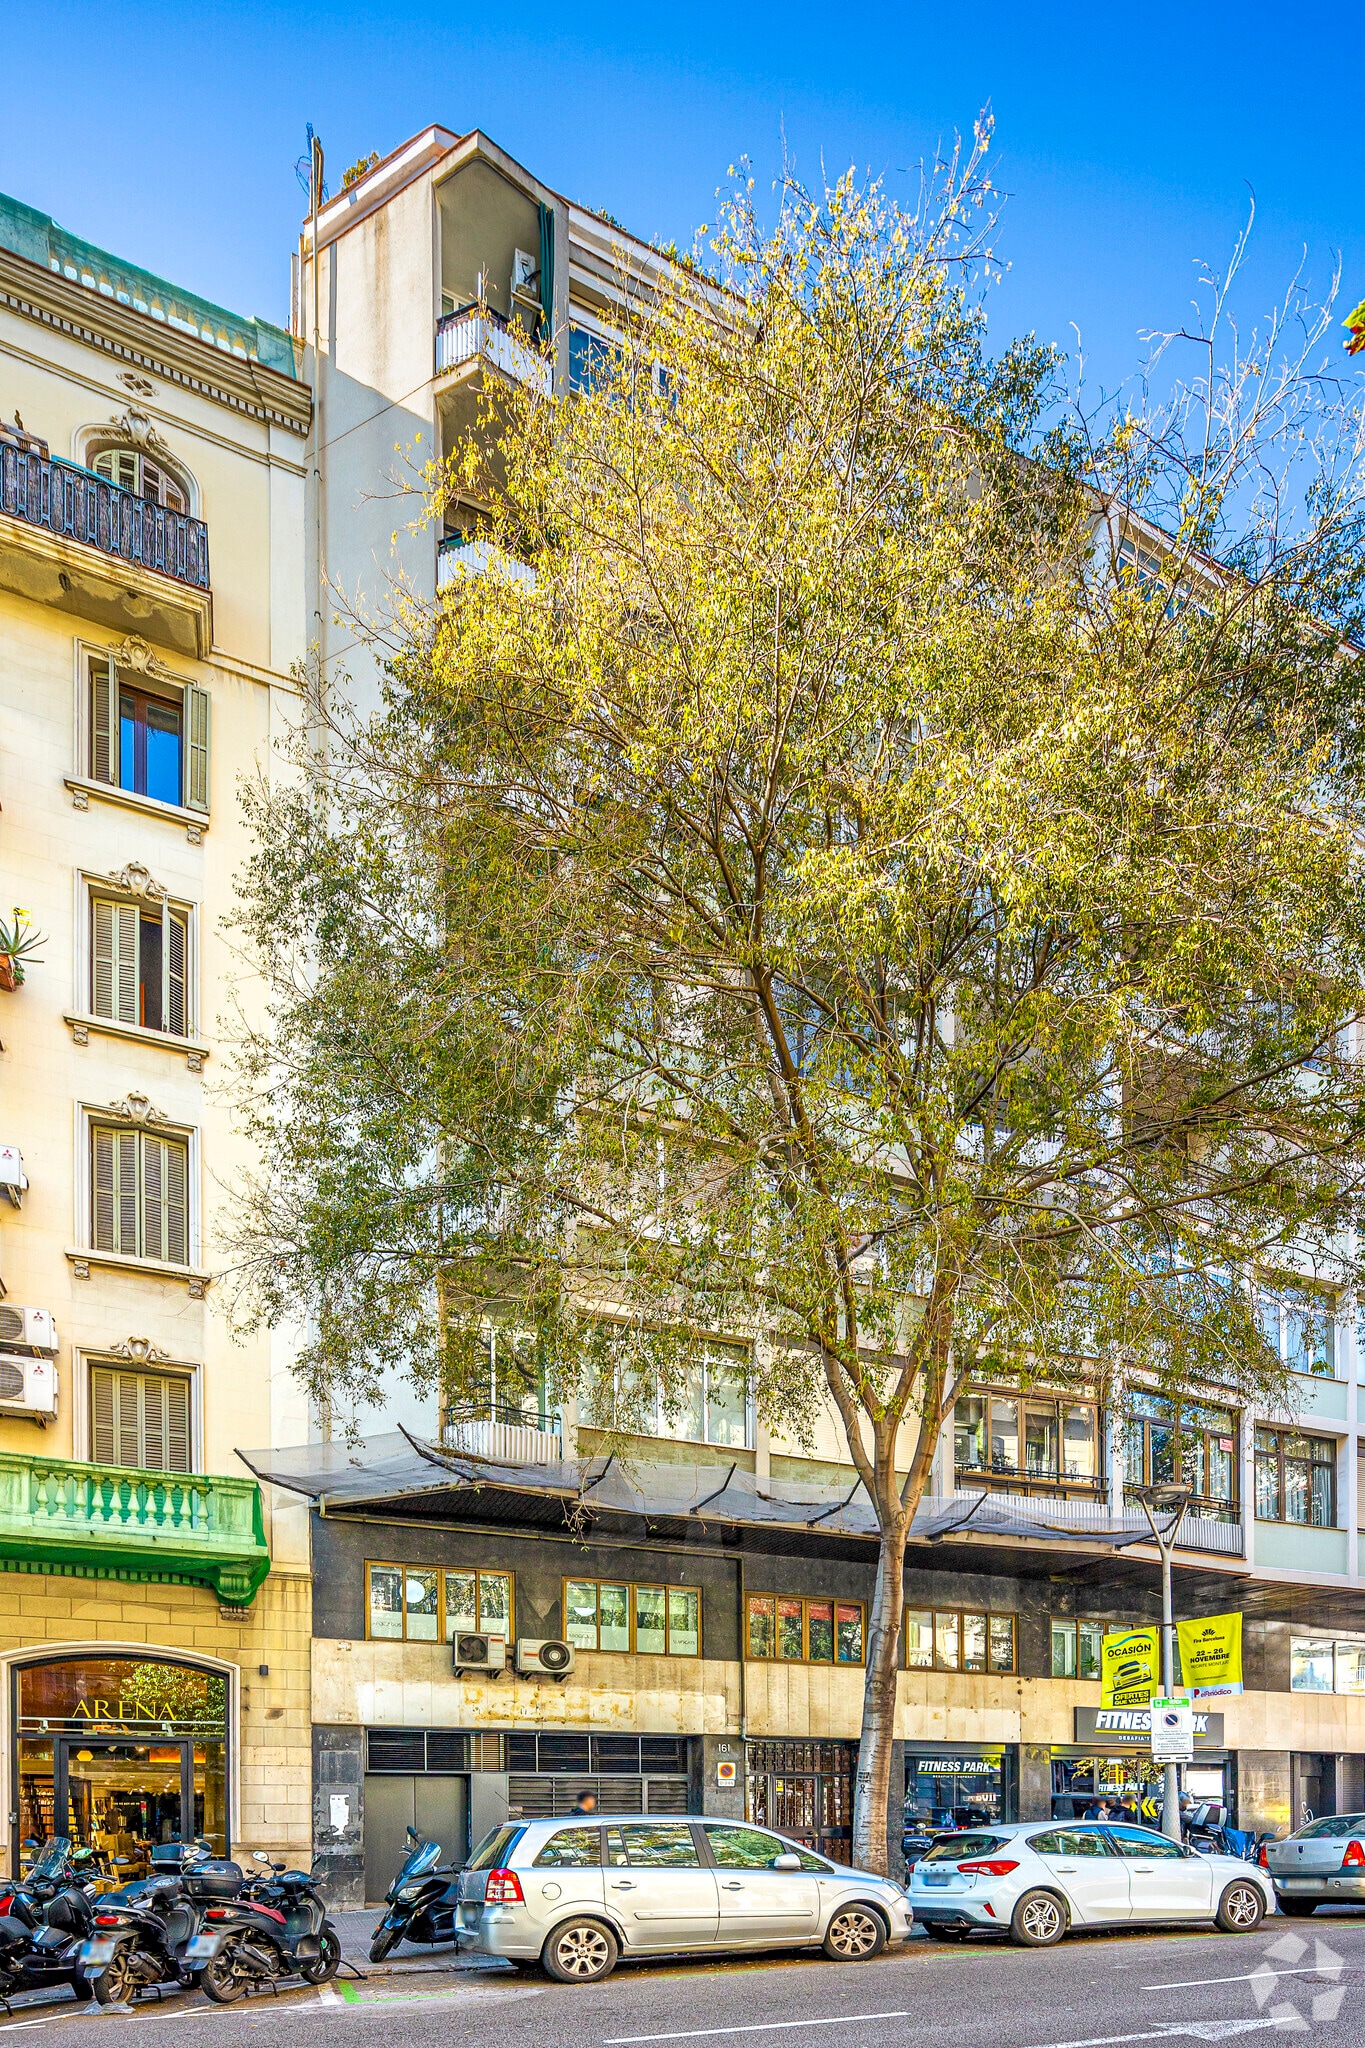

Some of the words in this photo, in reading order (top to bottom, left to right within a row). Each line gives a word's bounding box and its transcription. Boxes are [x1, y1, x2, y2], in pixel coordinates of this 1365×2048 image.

[1107, 1643, 1151, 1658] OCASIÓN
[1190, 1652, 1230, 1664] NOVEMBRE
[1114, 1690, 1149, 1700] OFERTES
[72, 1699, 177, 1721] ARENA
[1095, 1711, 1152, 1731] FITNES
[718, 1743, 730, 1753] 161
[917, 1761, 961, 1772] FITNESS
[962, 1761, 991, 1773] PARK
